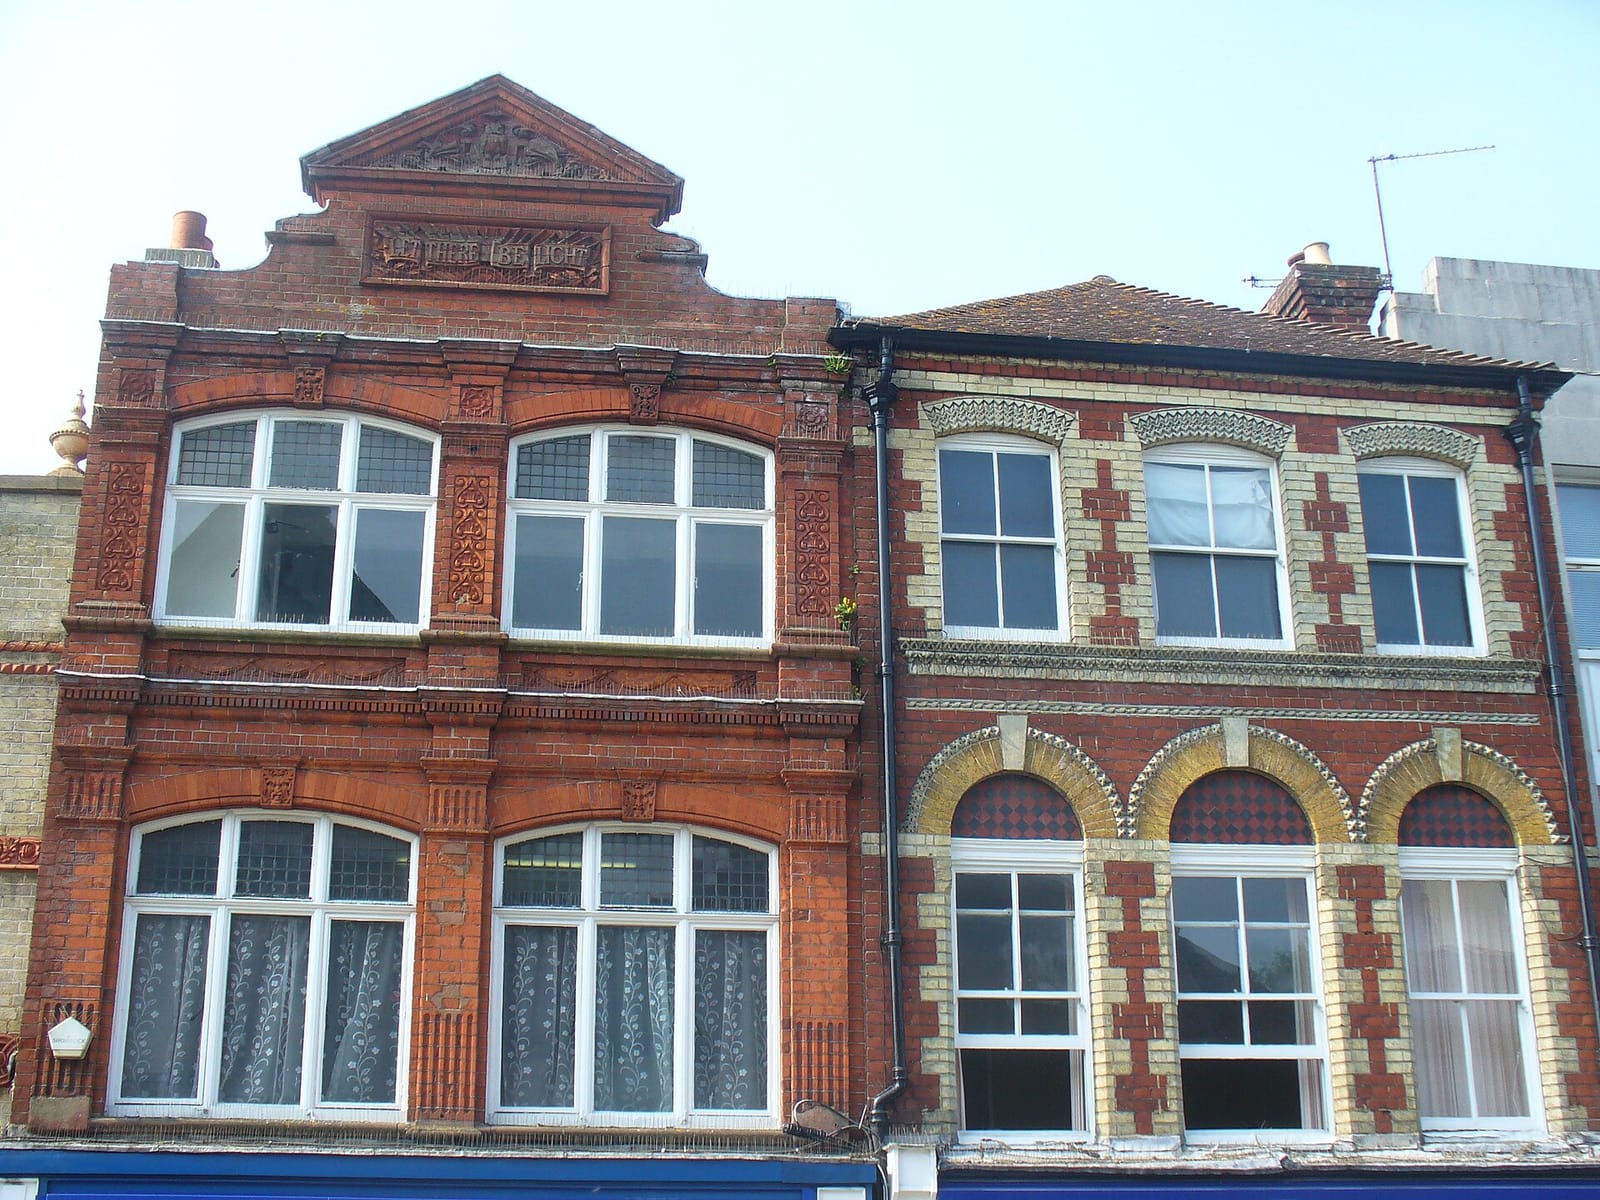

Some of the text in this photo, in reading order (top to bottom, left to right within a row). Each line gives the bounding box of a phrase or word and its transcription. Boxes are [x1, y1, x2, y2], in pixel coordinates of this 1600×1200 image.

[389, 238, 588, 267] LET THERE BE LIGHT
